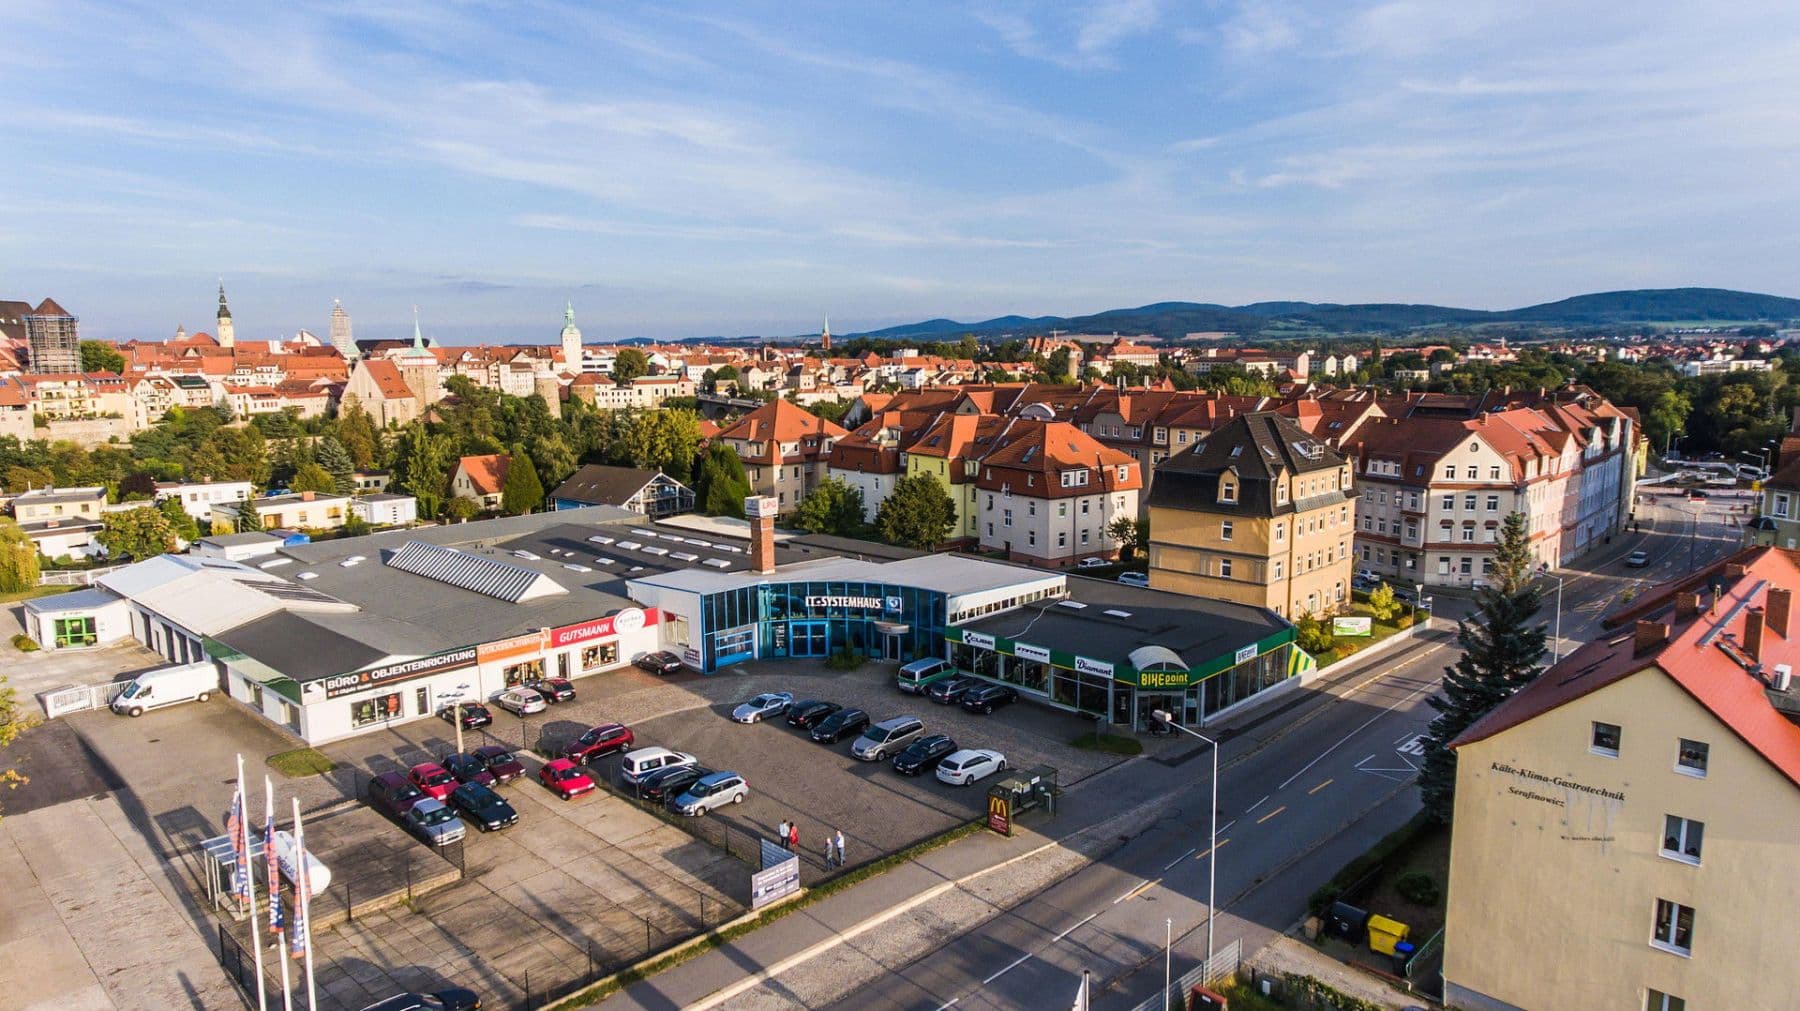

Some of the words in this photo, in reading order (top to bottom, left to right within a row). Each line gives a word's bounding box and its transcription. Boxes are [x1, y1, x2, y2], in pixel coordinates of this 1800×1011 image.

[559, 623, 610, 643] GUTSMANN
[327, 674, 359, 690] BÜRO
[360, 671, 370, 683] &
[371, 648, 476, 680] OBJEKTEINRICHTUNG
[1076, 658, 1113, 677] Diamant
[1491, 761, 1627, 802] Kälte-Klima-Gastrotechnik
[1507, 785, 1566, 808] Serafinowicz
